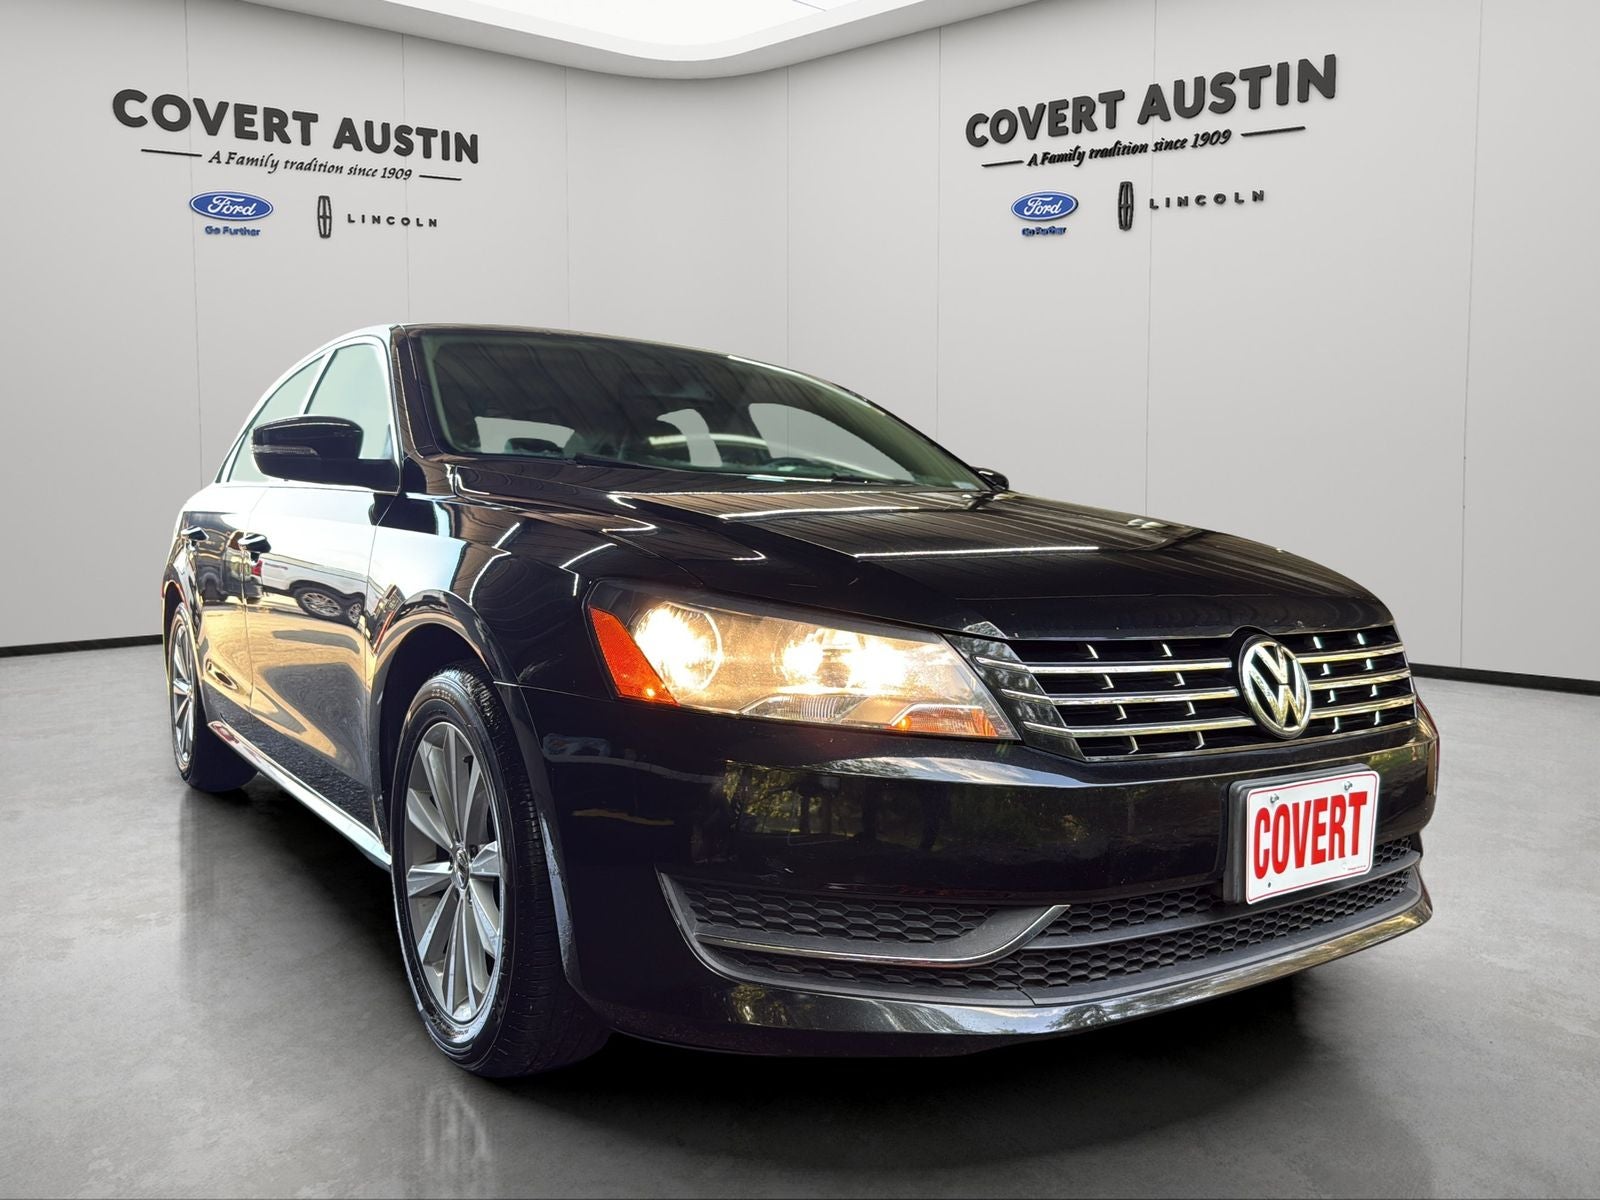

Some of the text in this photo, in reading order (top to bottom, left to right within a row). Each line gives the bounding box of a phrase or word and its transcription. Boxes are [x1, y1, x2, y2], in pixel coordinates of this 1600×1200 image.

[965, 53, 1336, 147] COVERT AUSTIN
[112, 88, 479, 164] COVERT AUSTIN
[1027, 129, 1232, 167] A Family tradition since 1909
[208, 150, 412, 181] A Family tradition since 1909
[207, 195, 257, 216] Ford
[1023, 196, 1063, 216] Ford
[1149, 189, 1265, 210] LINCOLN
[222, 225, 261, 236] Further
[347, 213, 438, 228] LINCOLN
[1254, 790, 1368, 880] COVERT
